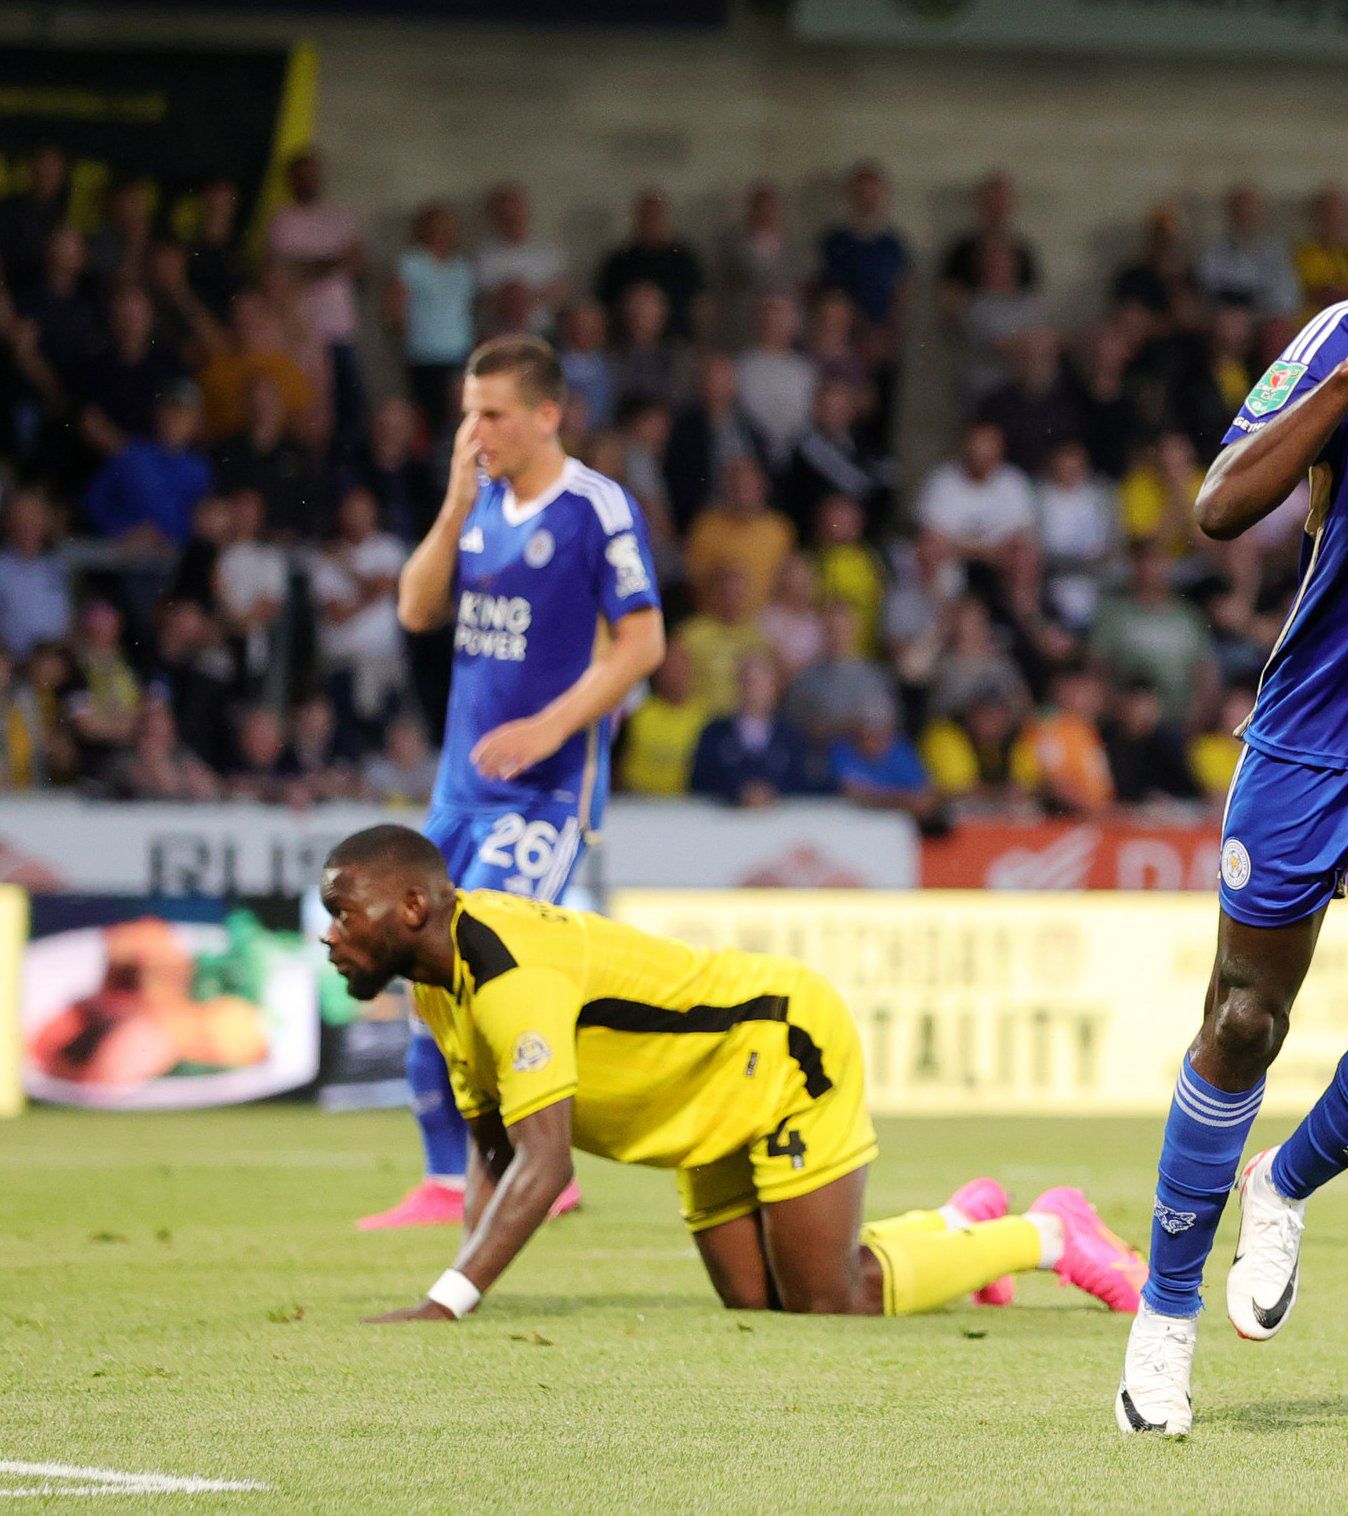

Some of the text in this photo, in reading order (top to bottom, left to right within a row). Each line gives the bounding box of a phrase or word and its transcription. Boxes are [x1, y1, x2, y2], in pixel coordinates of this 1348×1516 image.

[458, 590, 532, 634] KING
[480, 812, 559, 880] 26
[767, 1112, 806, 1171] 4
